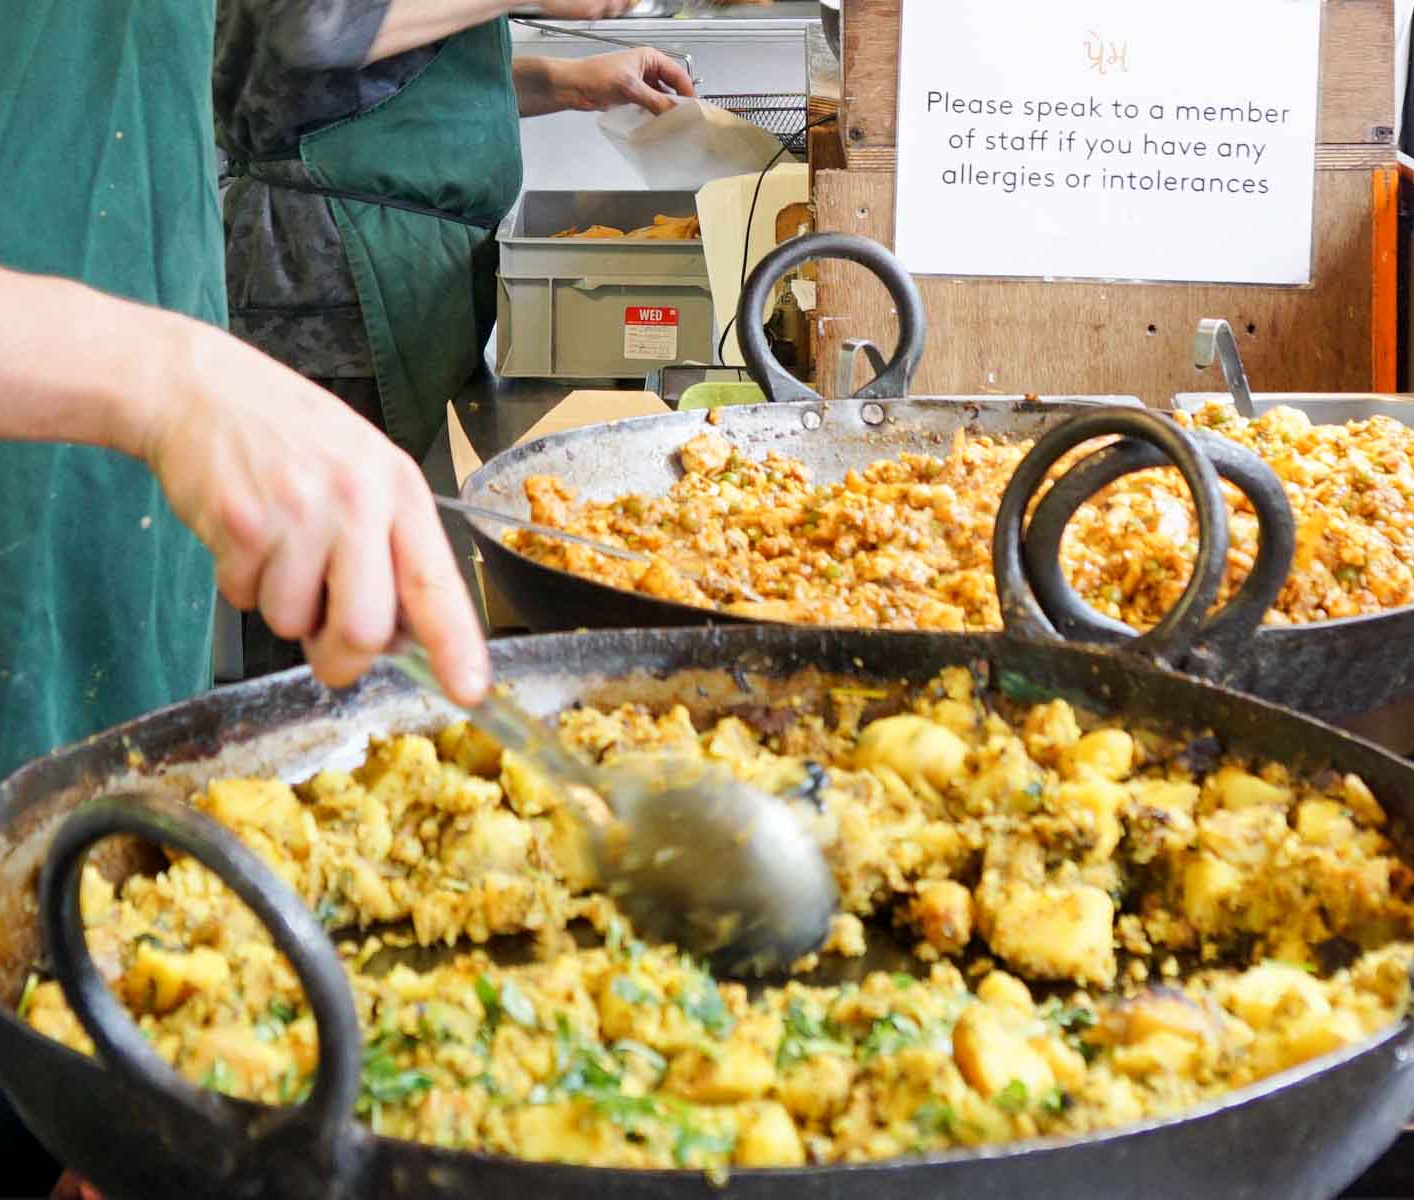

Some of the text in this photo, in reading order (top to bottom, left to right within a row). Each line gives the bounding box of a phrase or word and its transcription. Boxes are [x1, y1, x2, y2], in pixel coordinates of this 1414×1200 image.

[927, 91, 1292, 124] Please speak to a member
[948, 128, 1267, 165] of staff if you have any
[942, 163, 1270, 195] allergies or intolerances
[639, 309, 663, 321] WED
